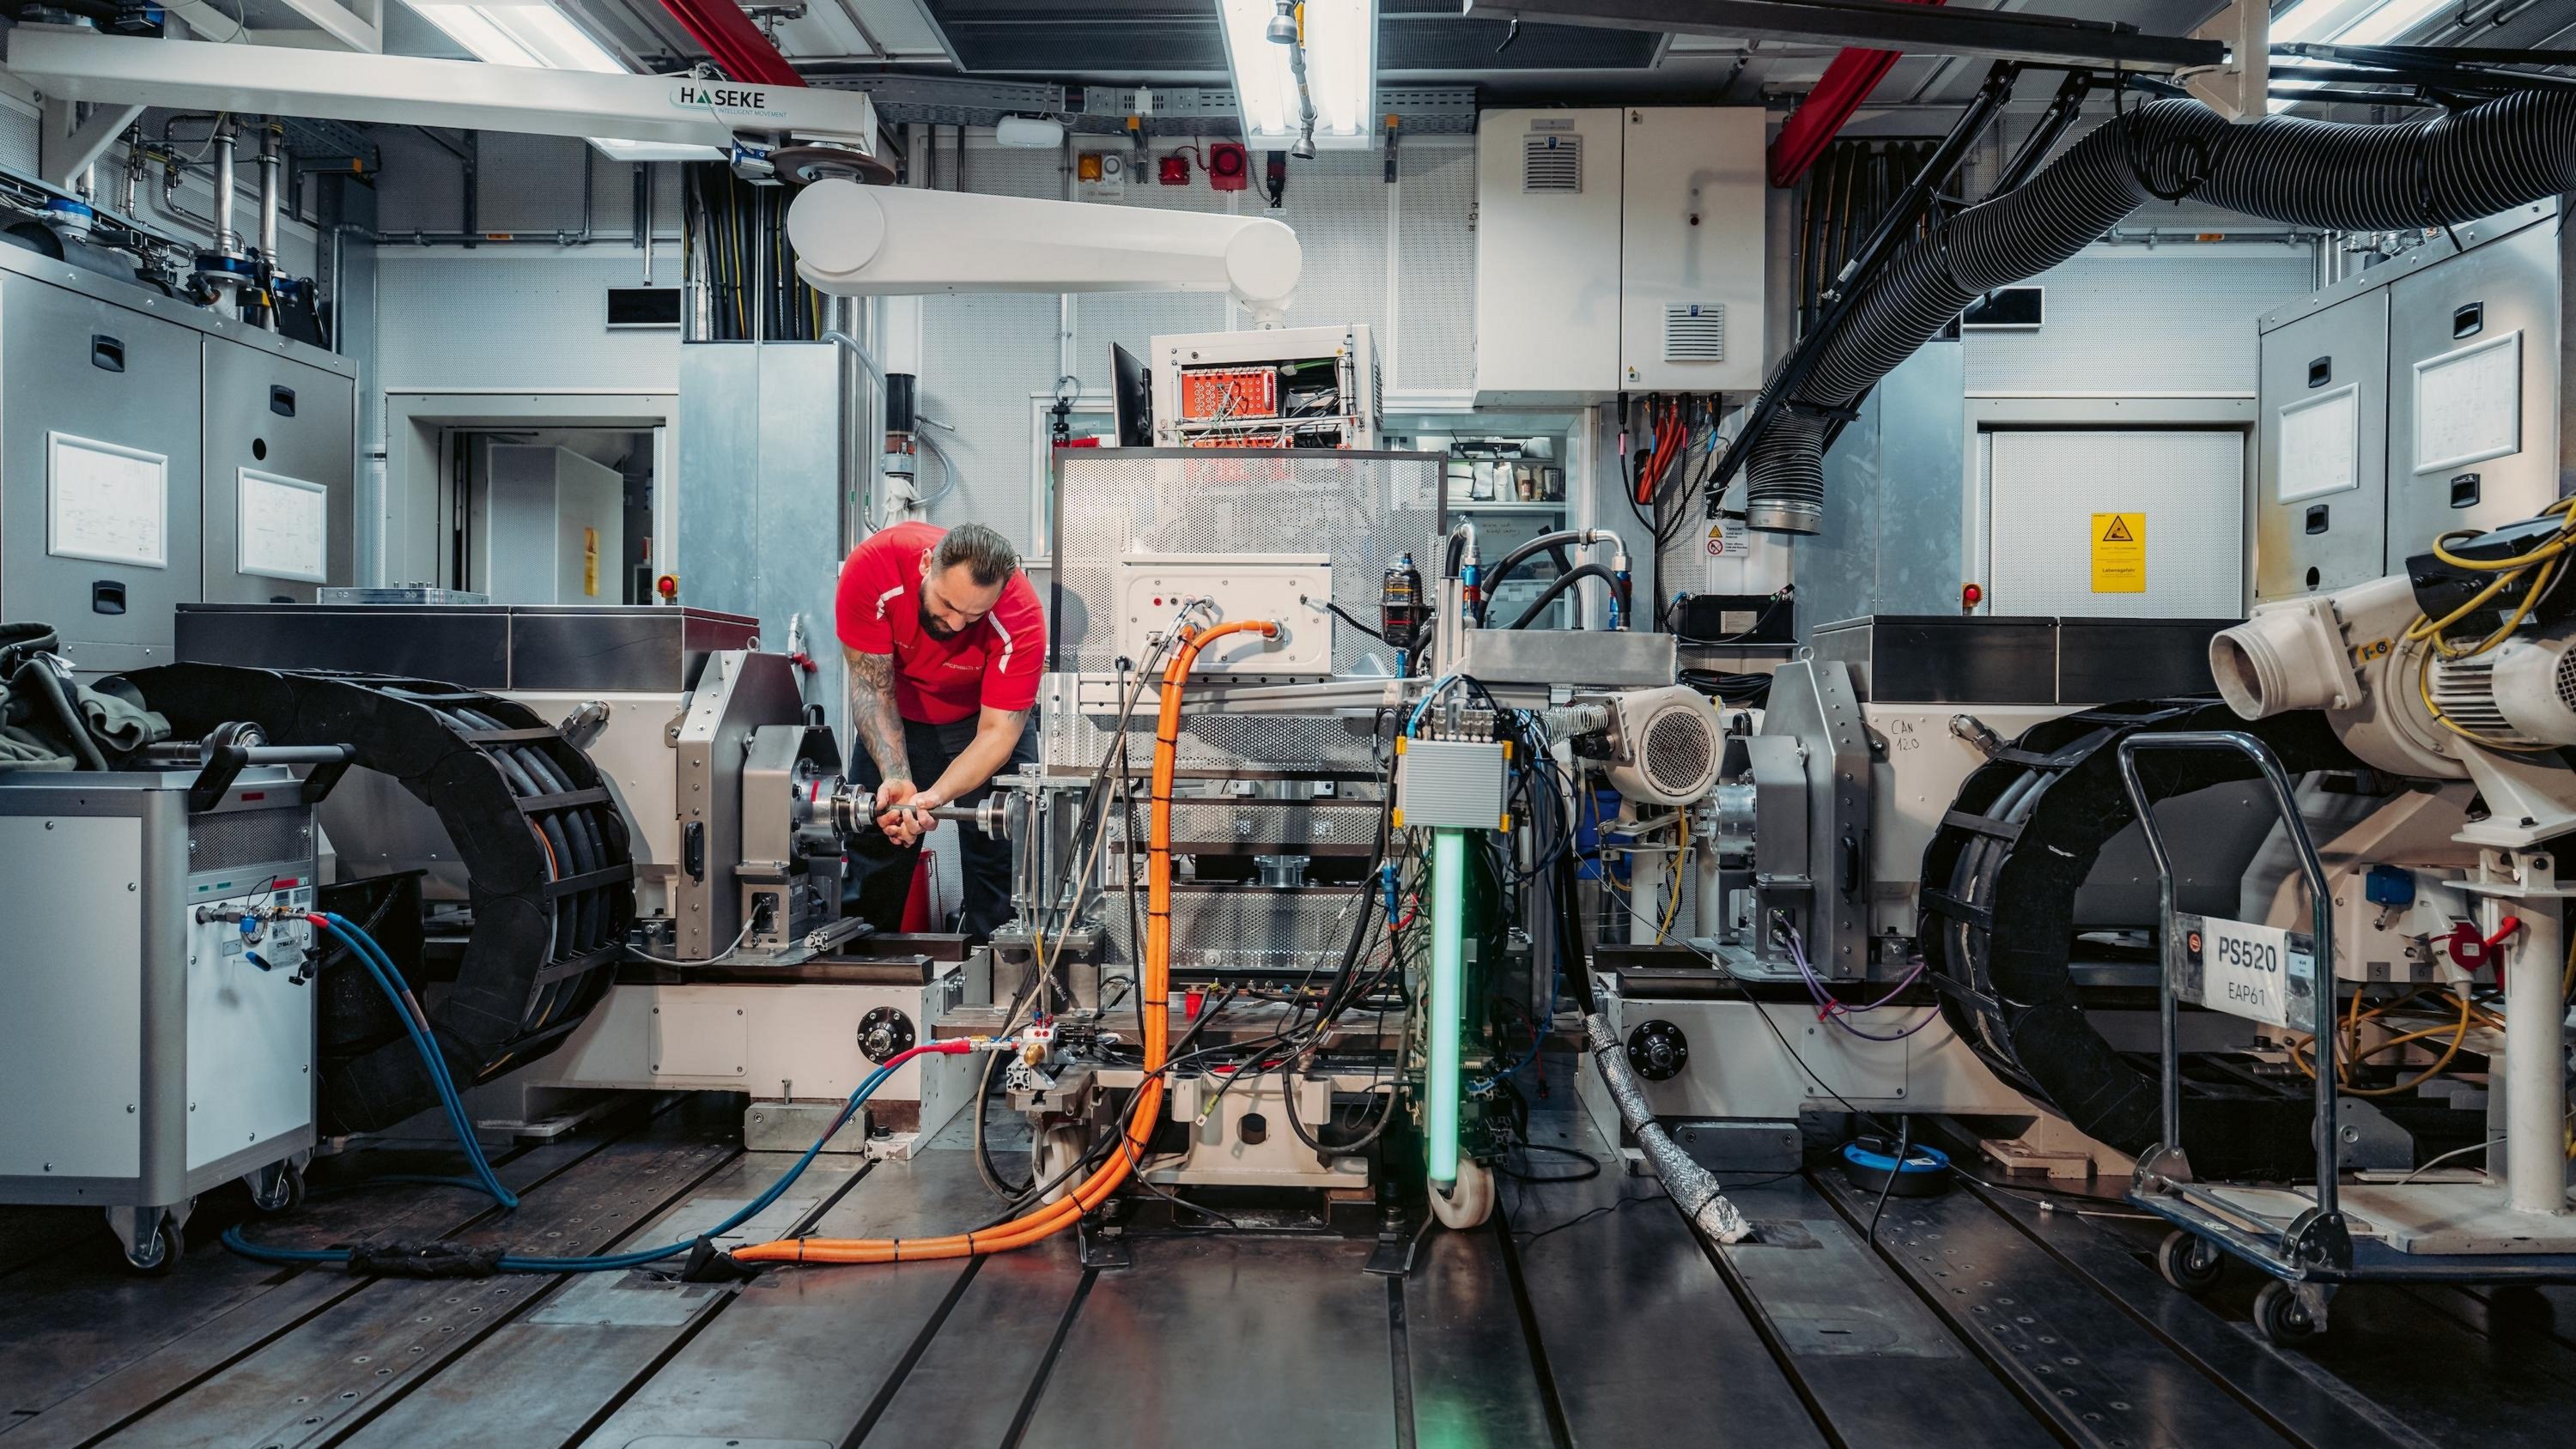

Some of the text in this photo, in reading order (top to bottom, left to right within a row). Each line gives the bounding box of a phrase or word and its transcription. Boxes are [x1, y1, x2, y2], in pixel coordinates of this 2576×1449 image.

[680, 87, 765, 109] HASEKE
[718, 107, 754, 116] INTELLIGENT
[1891, 719, 1914, 735] CAN
[2219, 936, 2277, 973] PS520
[2375, 967, 2382, 977] 5
[2418, 966, 2426, 977] 6
[2228, 981, 2265, 1007] EAP61
